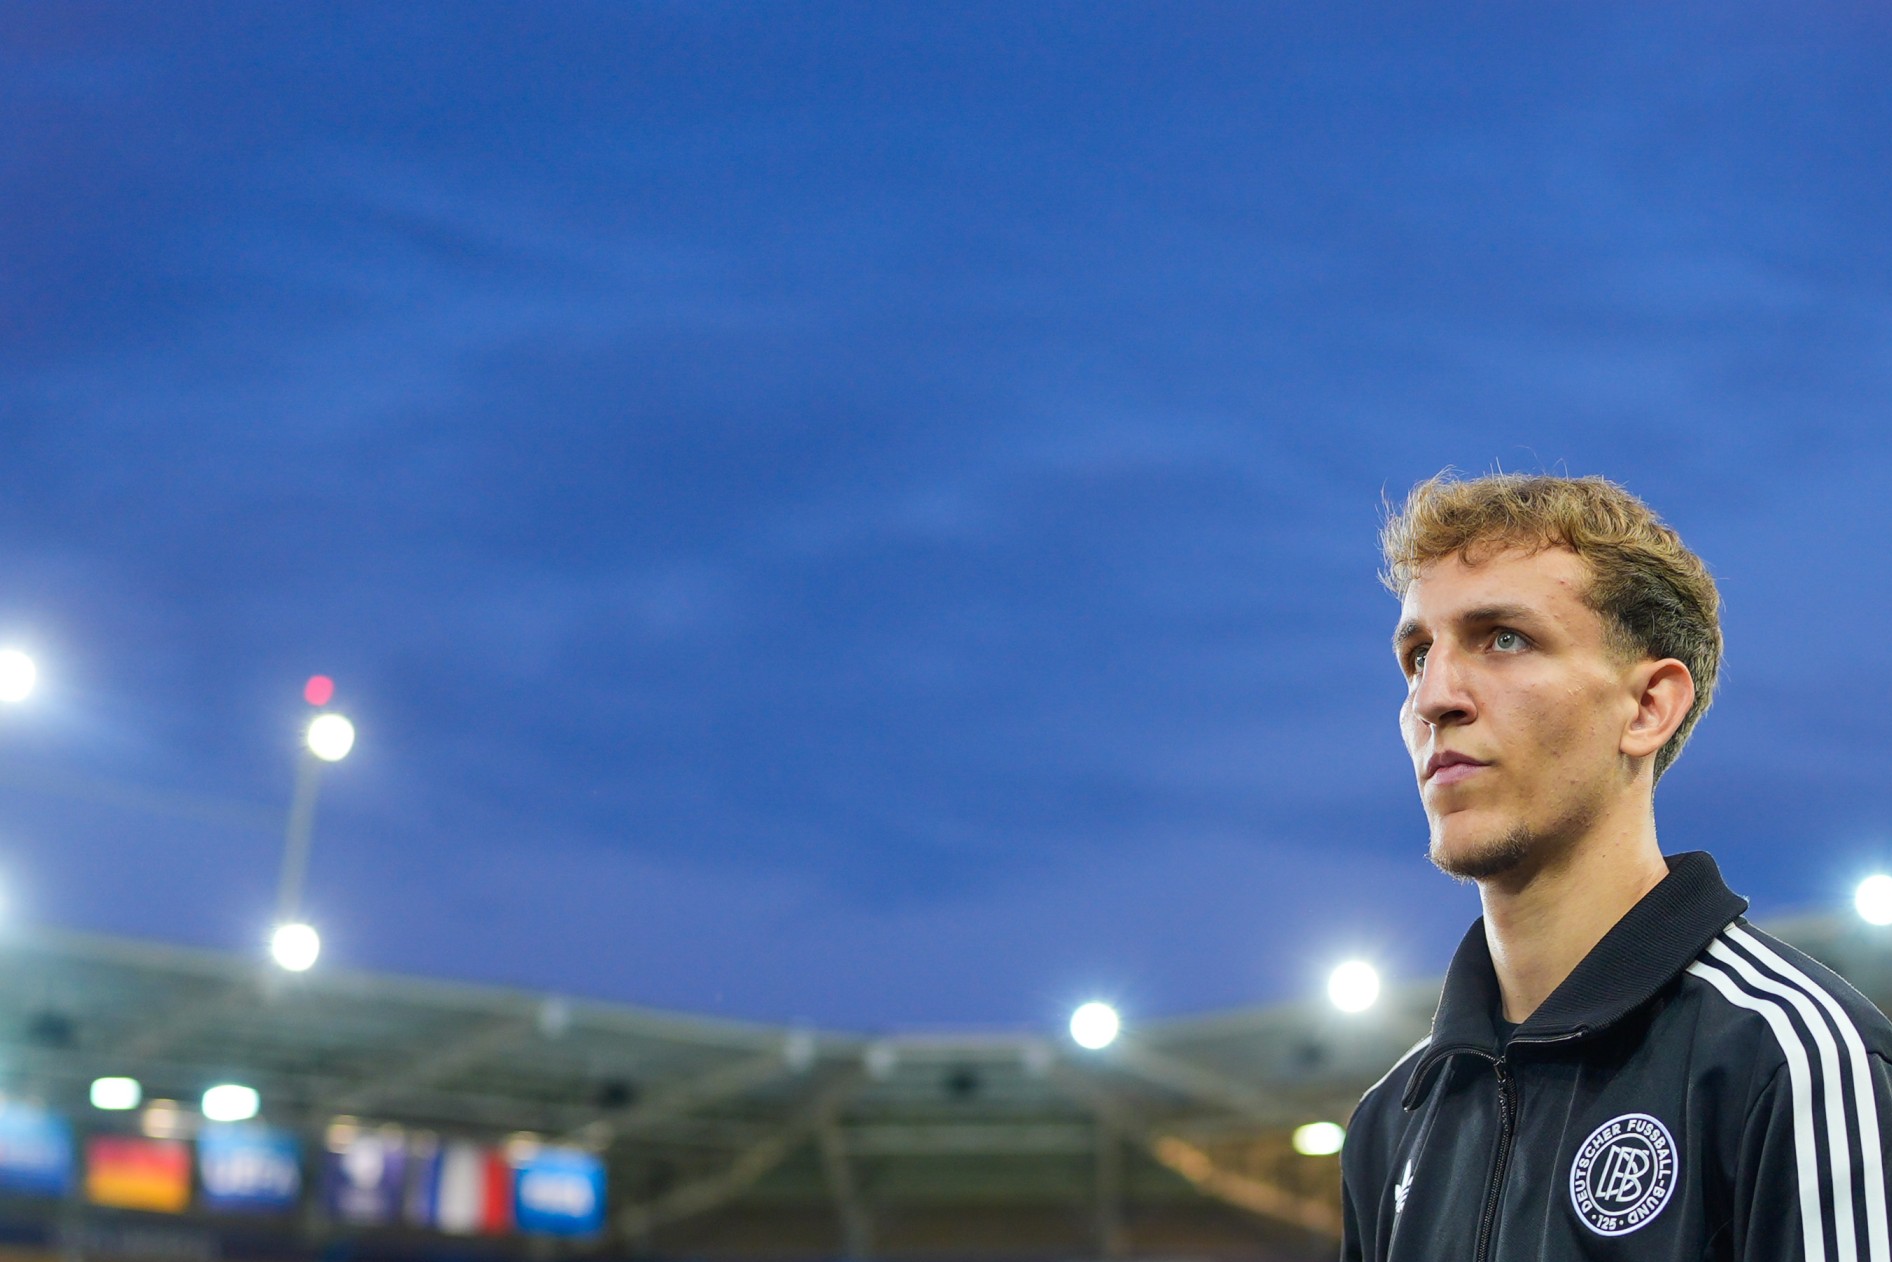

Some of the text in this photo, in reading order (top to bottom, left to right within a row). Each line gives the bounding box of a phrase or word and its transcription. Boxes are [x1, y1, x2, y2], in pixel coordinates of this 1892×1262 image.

[1574, 1119, 1672, 1225] DEUTSCHER FUSSBALL-BUND
[1597, 1215, 1618, 1230] 125
